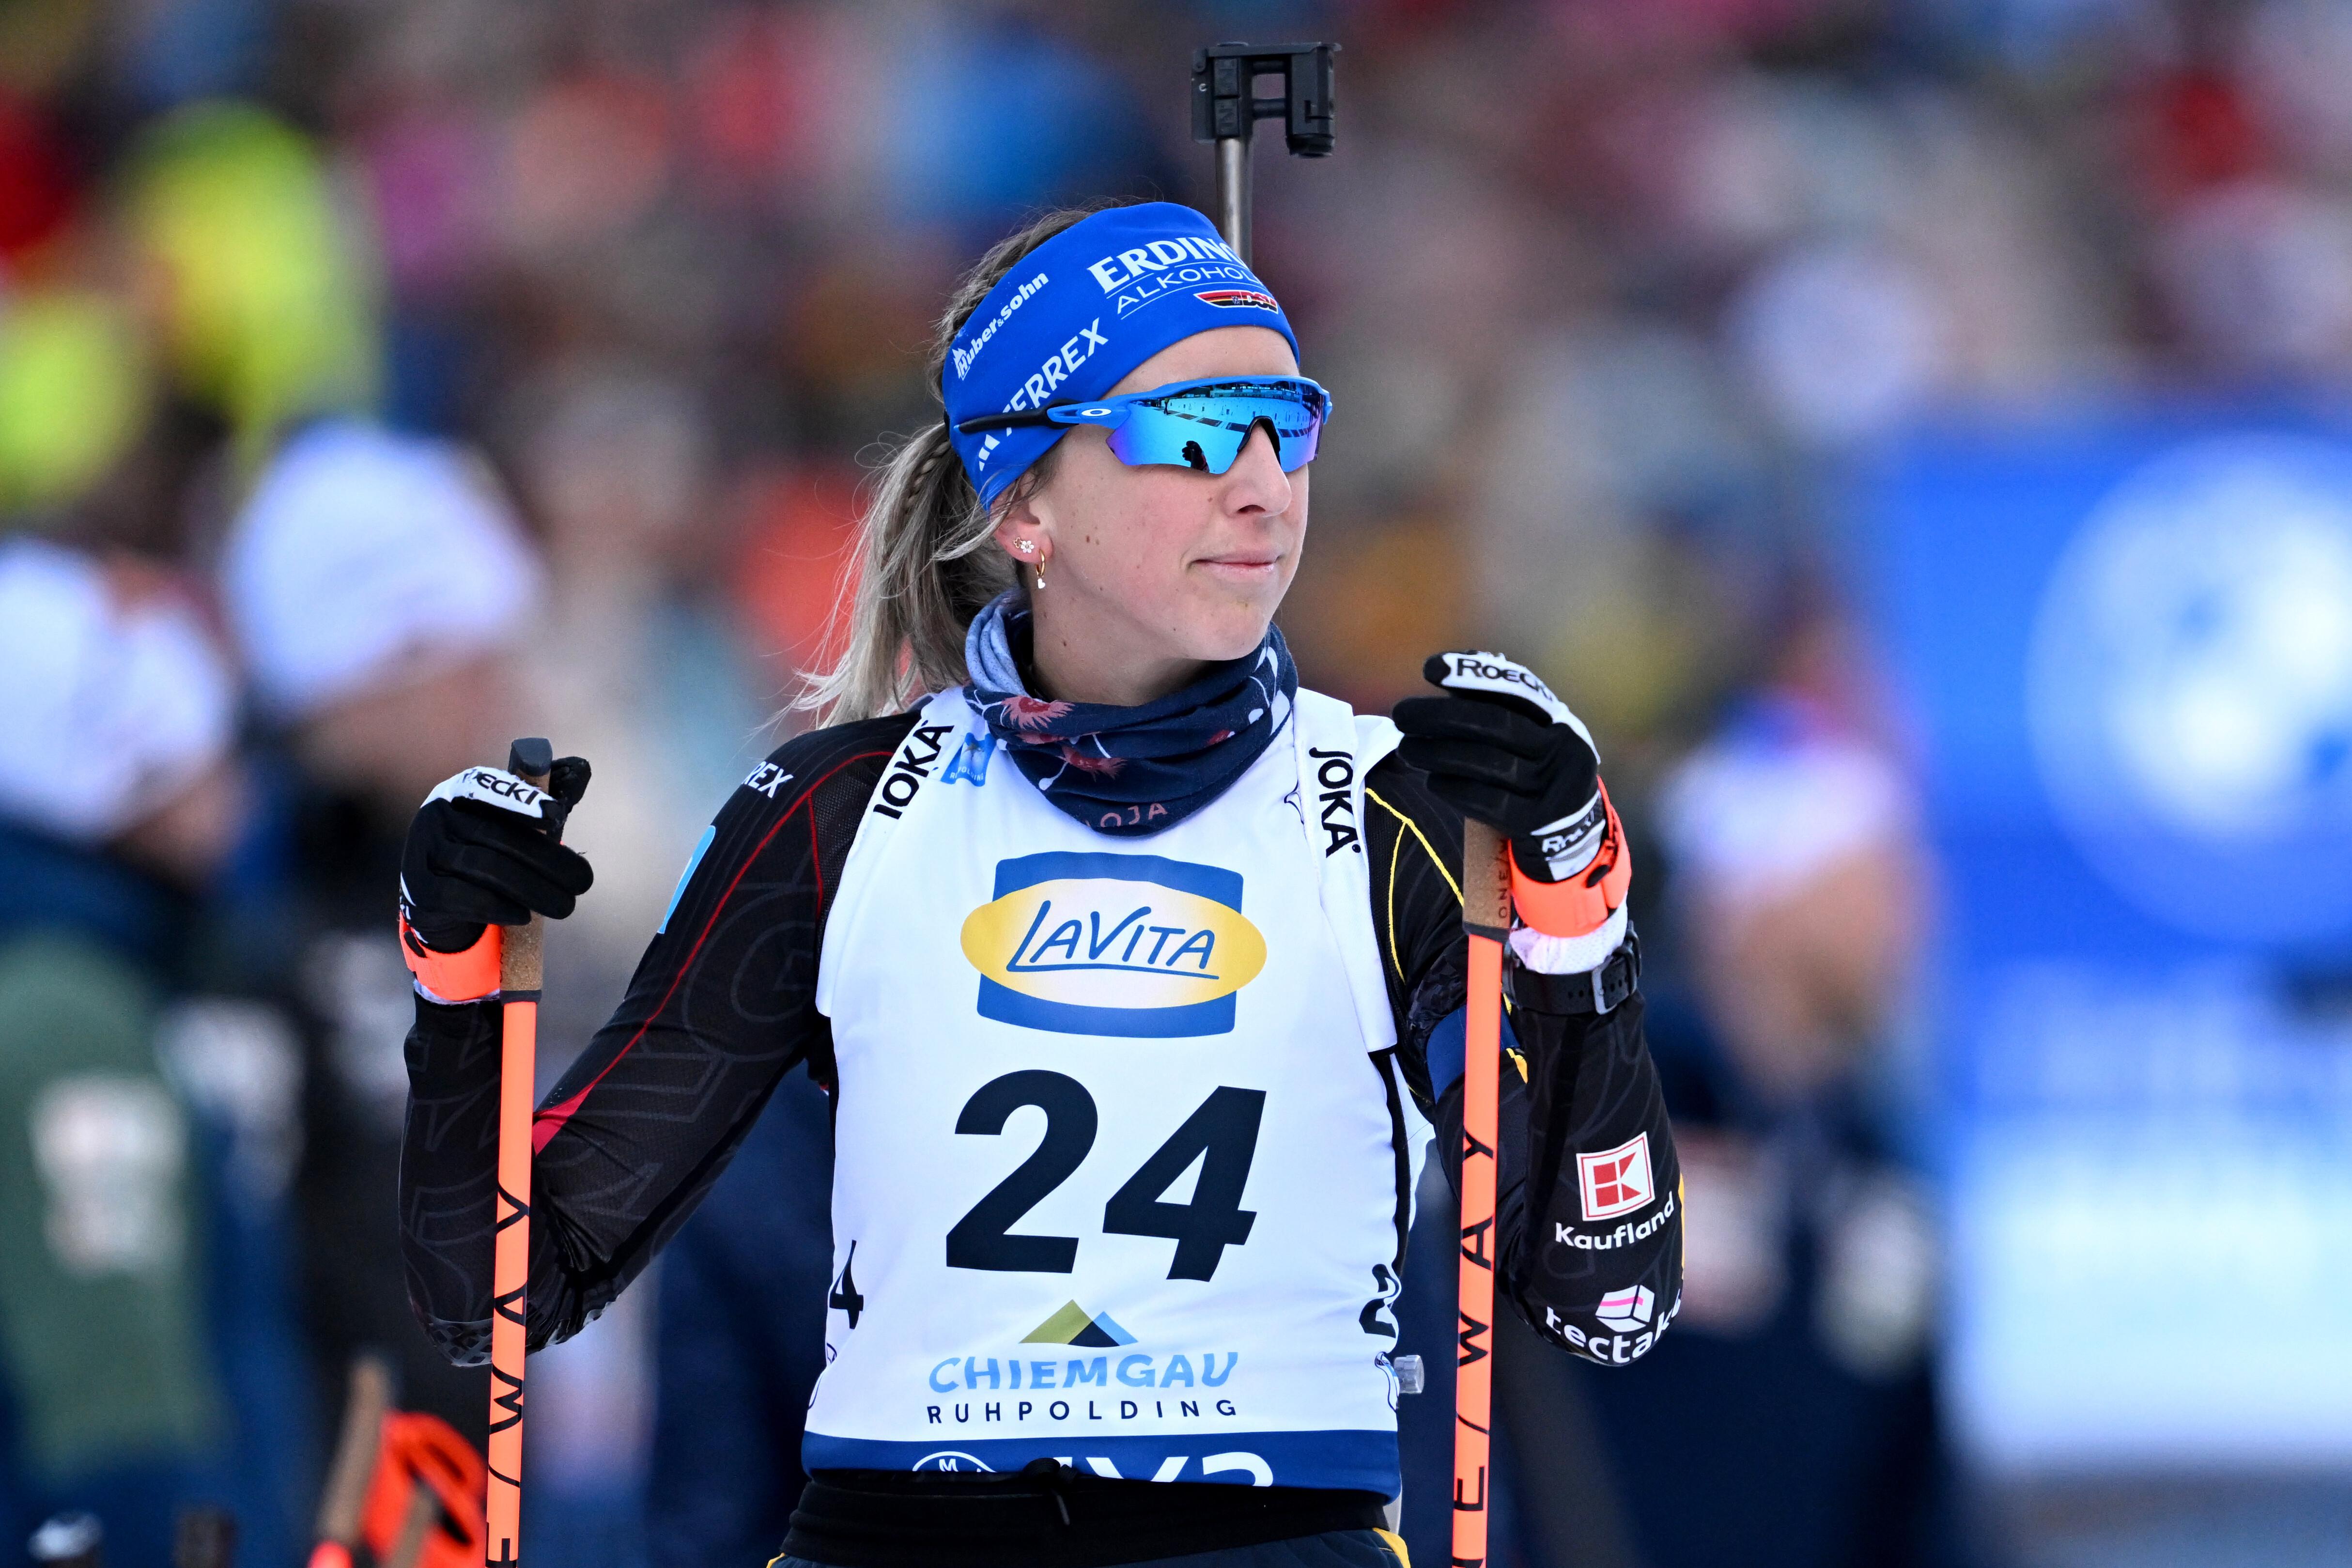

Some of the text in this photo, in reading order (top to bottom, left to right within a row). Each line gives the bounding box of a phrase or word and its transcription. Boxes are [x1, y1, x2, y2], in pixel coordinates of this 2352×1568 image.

[1085, 803, 1168, 827] OJA
[946, 1069, 1267, 1282] 24
[1555, 1191, 1674, 1250] Kaufland
[928, 1351, 1238, 1393] CHIEMGAU
[927, 1399, 1237, 1424] RUHPOLDING
